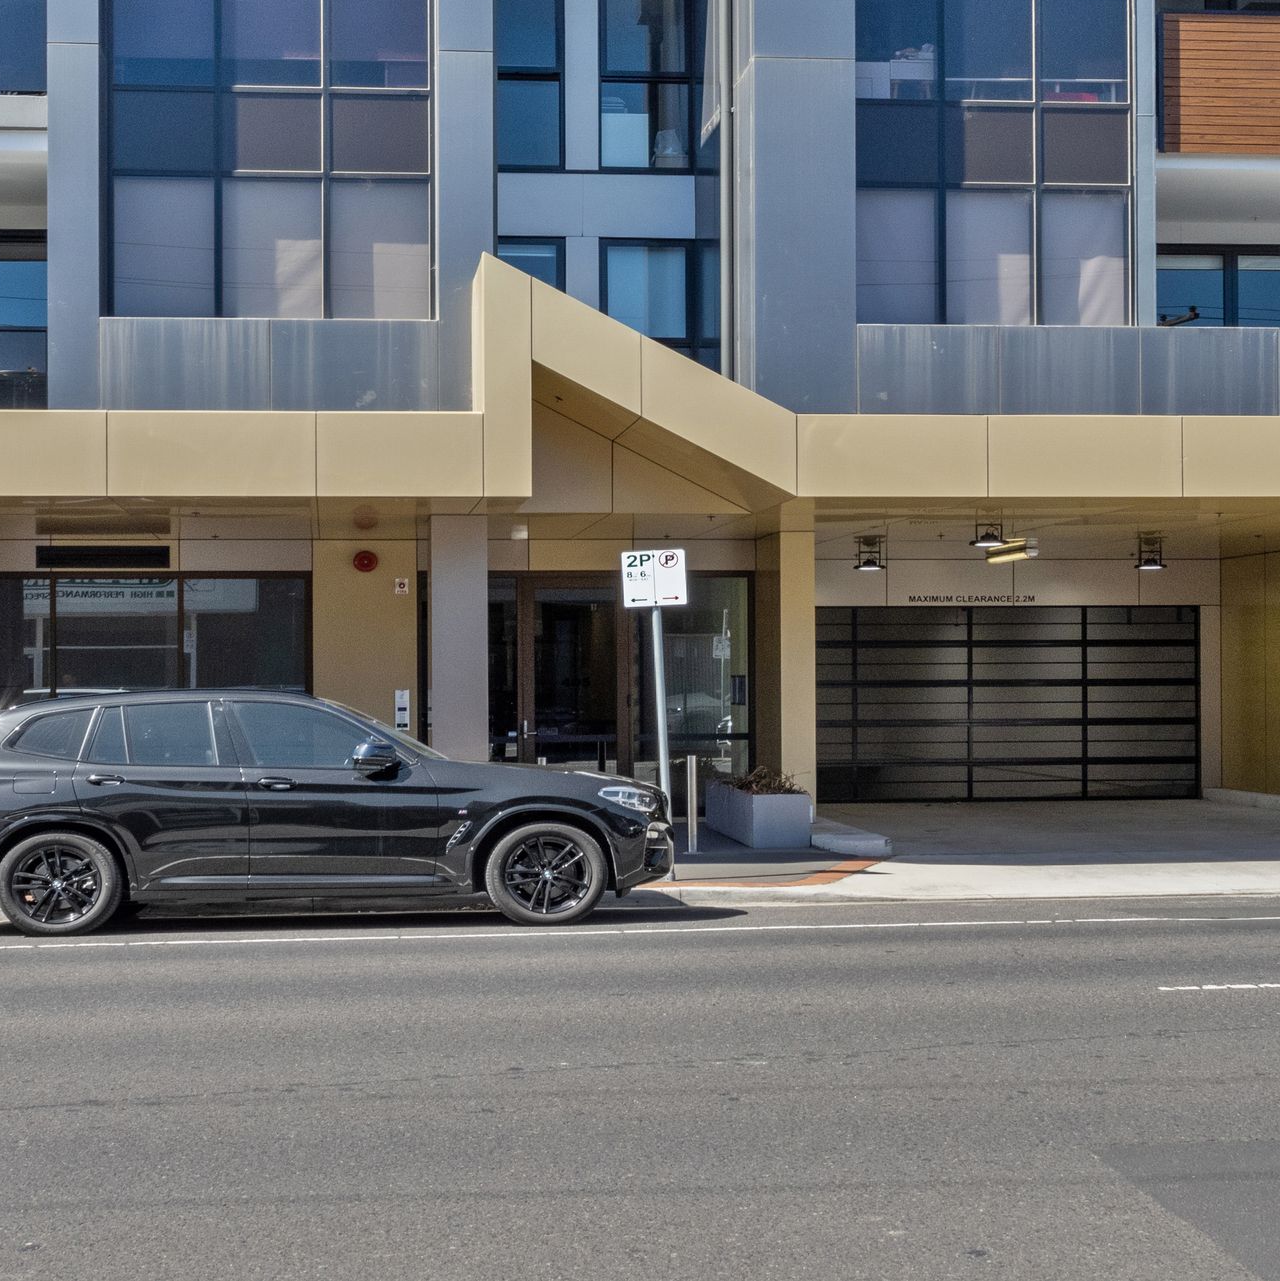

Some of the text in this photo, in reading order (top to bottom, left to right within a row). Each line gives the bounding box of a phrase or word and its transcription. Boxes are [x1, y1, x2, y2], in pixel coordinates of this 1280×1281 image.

[626, 554, 651, 568] 2P
[908, 595, 1036, 603] MAXIMUM CLEARANCE 2.2M
